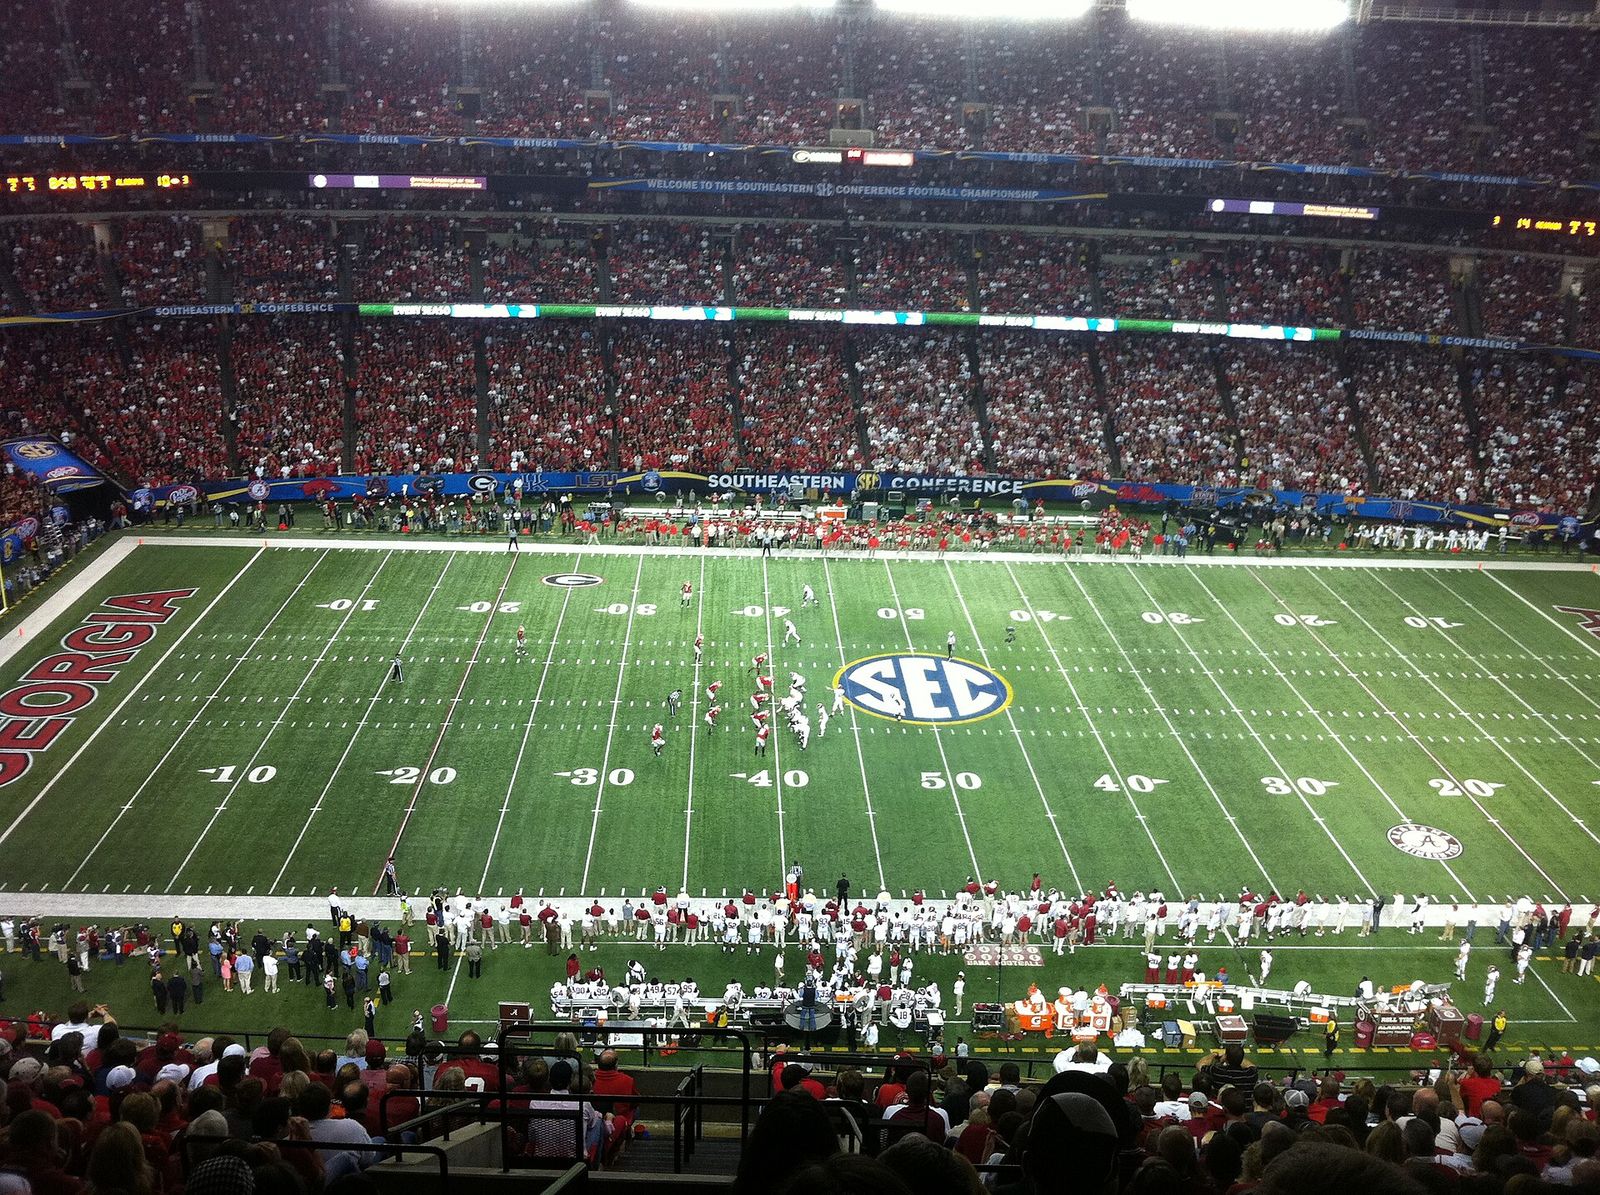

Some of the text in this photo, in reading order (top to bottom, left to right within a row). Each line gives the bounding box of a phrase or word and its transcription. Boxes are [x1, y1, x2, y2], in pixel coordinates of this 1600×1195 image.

[24, 135, 64, 144] AUBURN
[195, 134, 235, 143] FLORIDA
[359, 135, 399, 144] GEORGIA
[513, 139, 558, 149] KENTUCKY
[1304, 165, 1349, 175] MISSOURI
[647, 179, 698, 190] WELCOME
[699, 181, 713, 190] TO
[714, 181, 735, 191] THE
[736, 182, 814, 194] SOUTHEASTERN
[835, 185, 906, 196] CONFERENCE
[907, 187, 959, 197] FOOTBALL
[960, 188, 1040, 199] CHAMPIONSHIP
[155, 305, 235, 316] SOUTHEASTERN
[259, 303, 334, 313] CONFERENCE
[1349, 329, 1423, 342] SOUTHEASTERN
[1445, 336, 1519, 350] CONFERENCE
[575, 475, 619, 489] LSU
[707, 473, 846, 490] SOUTHEASTERN
[891, 476, 1025, 495] CONFERENCE
[848, 656, 999, 720] SEC
[209, 765, 277, 783] 10
[389, 766, 457, 785] 20
[570, 768, 635, 786] 30
[747, 769, 809, 787] 40
[920, 771, 982, 789] 50
[1093, 774, 1155, 793] 40
[1260, 776, 1327, 796] 30
[1428, 778, 1495, 797] 20
[683, 984, 693, 994] 95
[899, 1011, 908, 1020] 18
